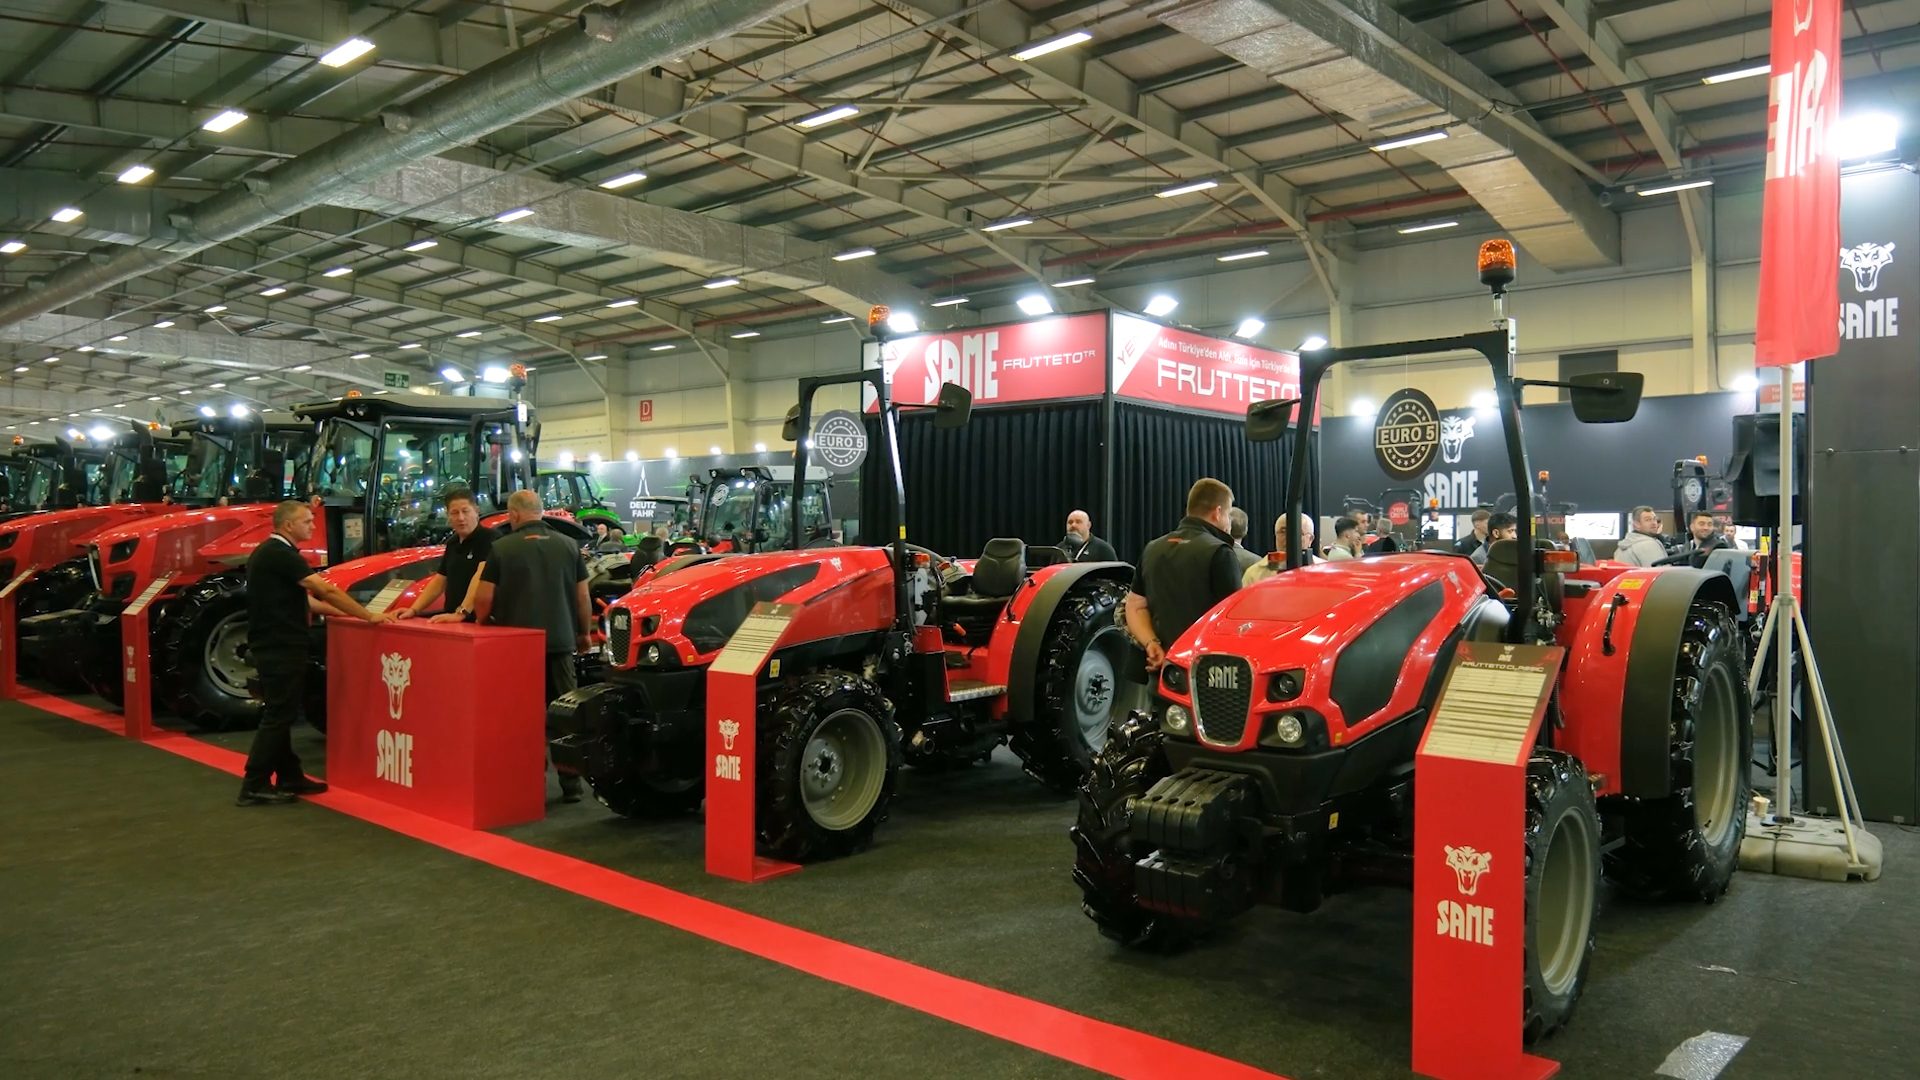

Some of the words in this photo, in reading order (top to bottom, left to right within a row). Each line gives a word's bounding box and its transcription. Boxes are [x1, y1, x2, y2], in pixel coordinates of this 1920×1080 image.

[924, 331, 999, 405] SAME
[1157, 358, 1300, 402] FRUTTETO
[819, 435, 853, 448] EURO
[856, 438, 864, 448] 5
[1380, 427, 1421, 445] EURO
[1426, 425, 1435, 440] 5
[1423, 470, 1479, 508] SAME
[629, 501, 656, 509] DEUTZ
[632, 509, 655, 518] FAHR
[1208, 665, 1239, 689] SAME
[376, 729, 413, 788] SAME
[715, 754, 741, 781] SAME
[1437, 900, 1494, 947] SAME
